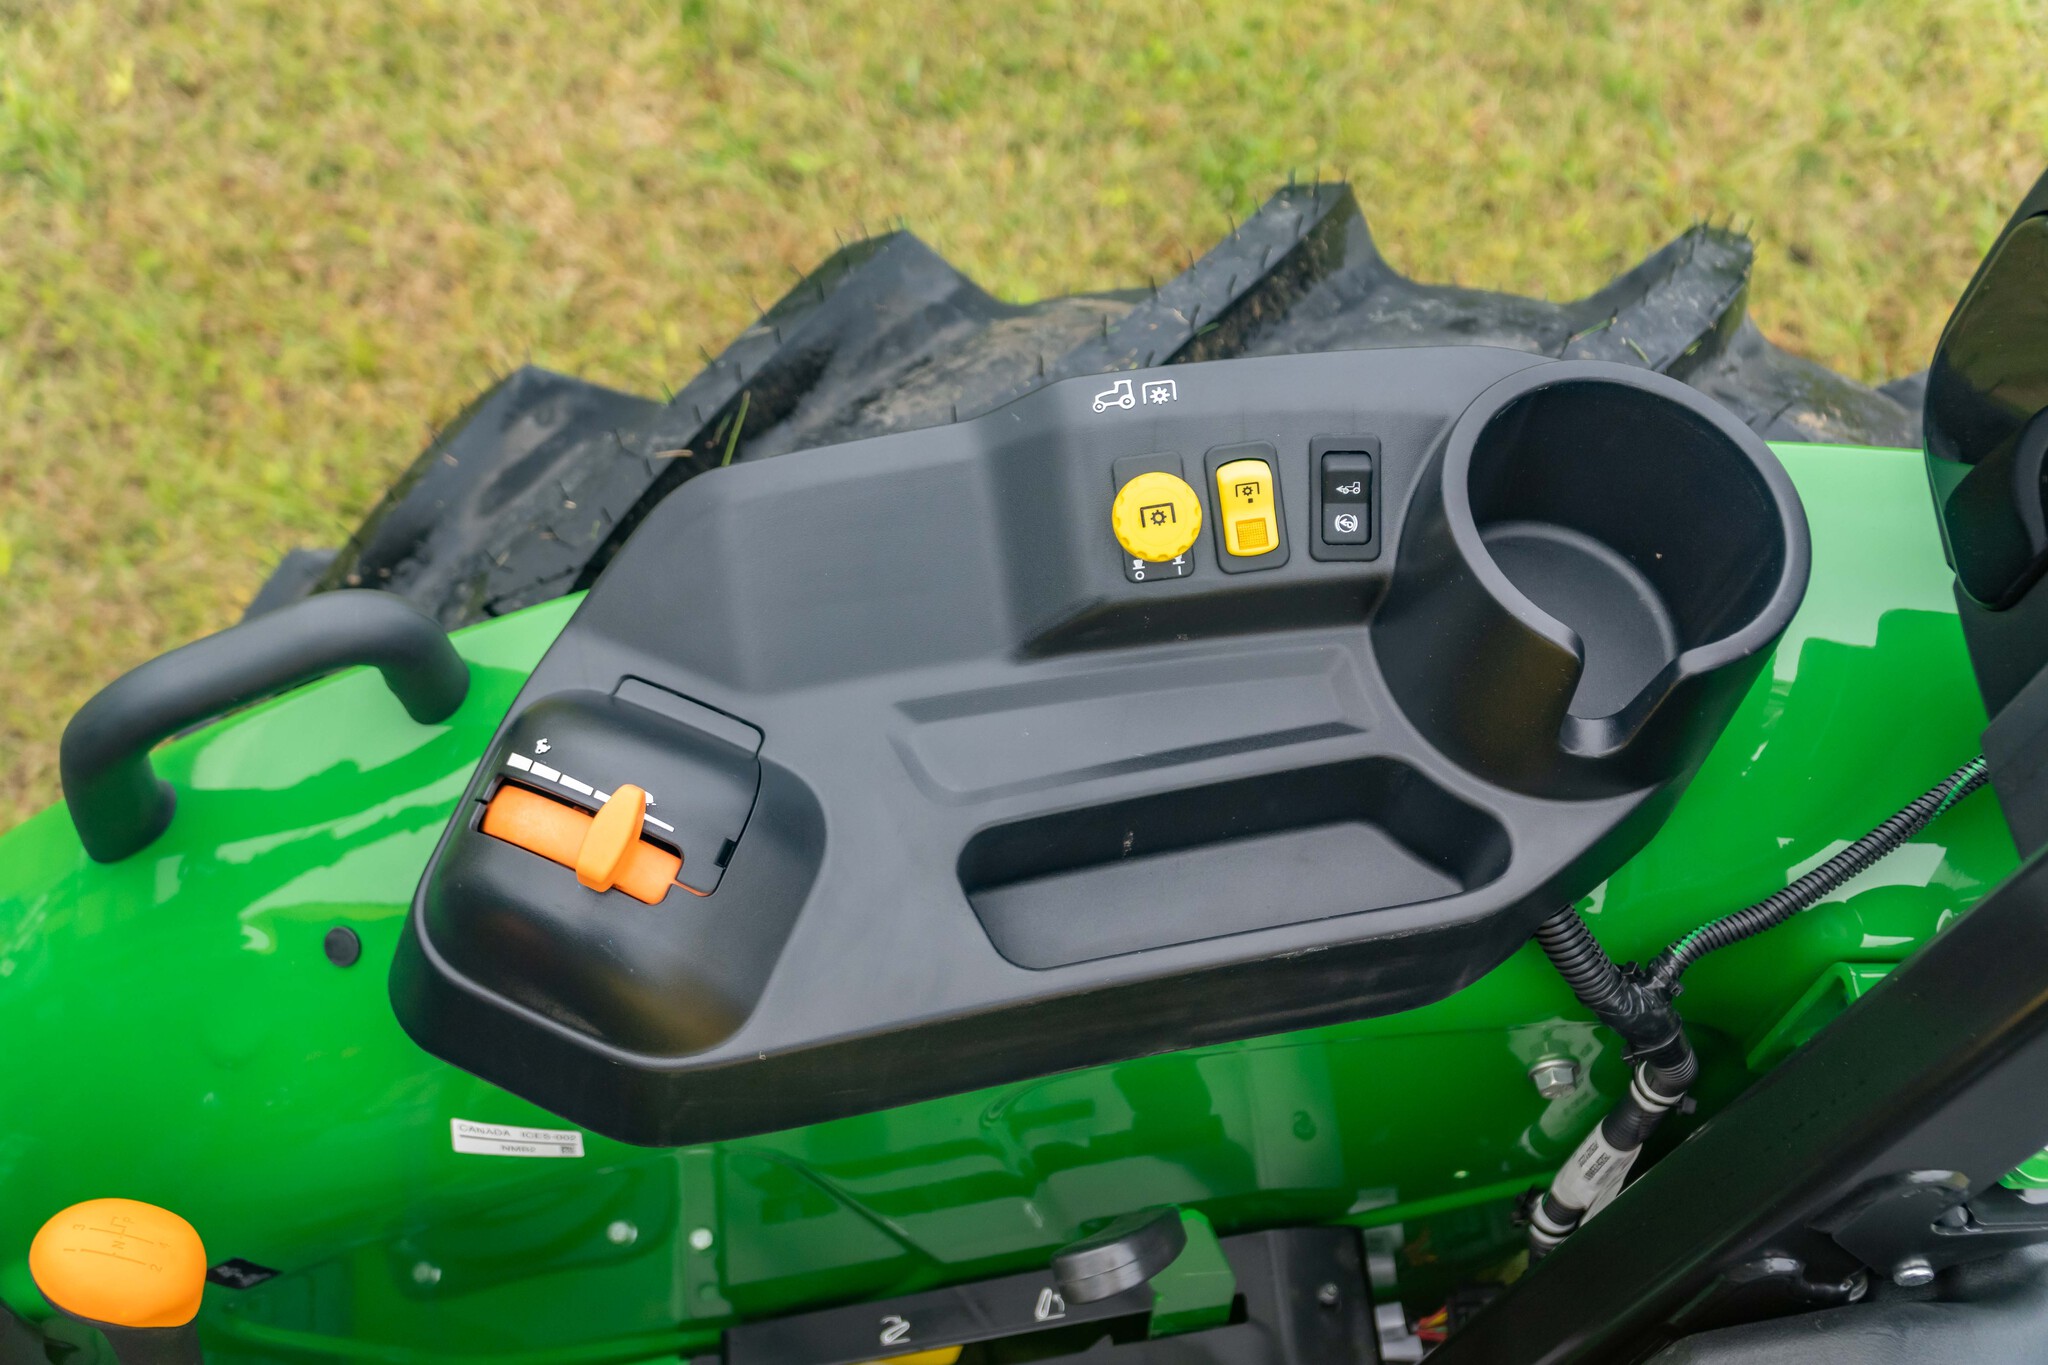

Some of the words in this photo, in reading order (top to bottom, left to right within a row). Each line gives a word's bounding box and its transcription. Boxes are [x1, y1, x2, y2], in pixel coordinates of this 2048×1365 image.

[459, 1124, 511, 1137] CANADA
[72, 1223, 86, 1231] 3
[150, 1263, 163, 1273] 2
